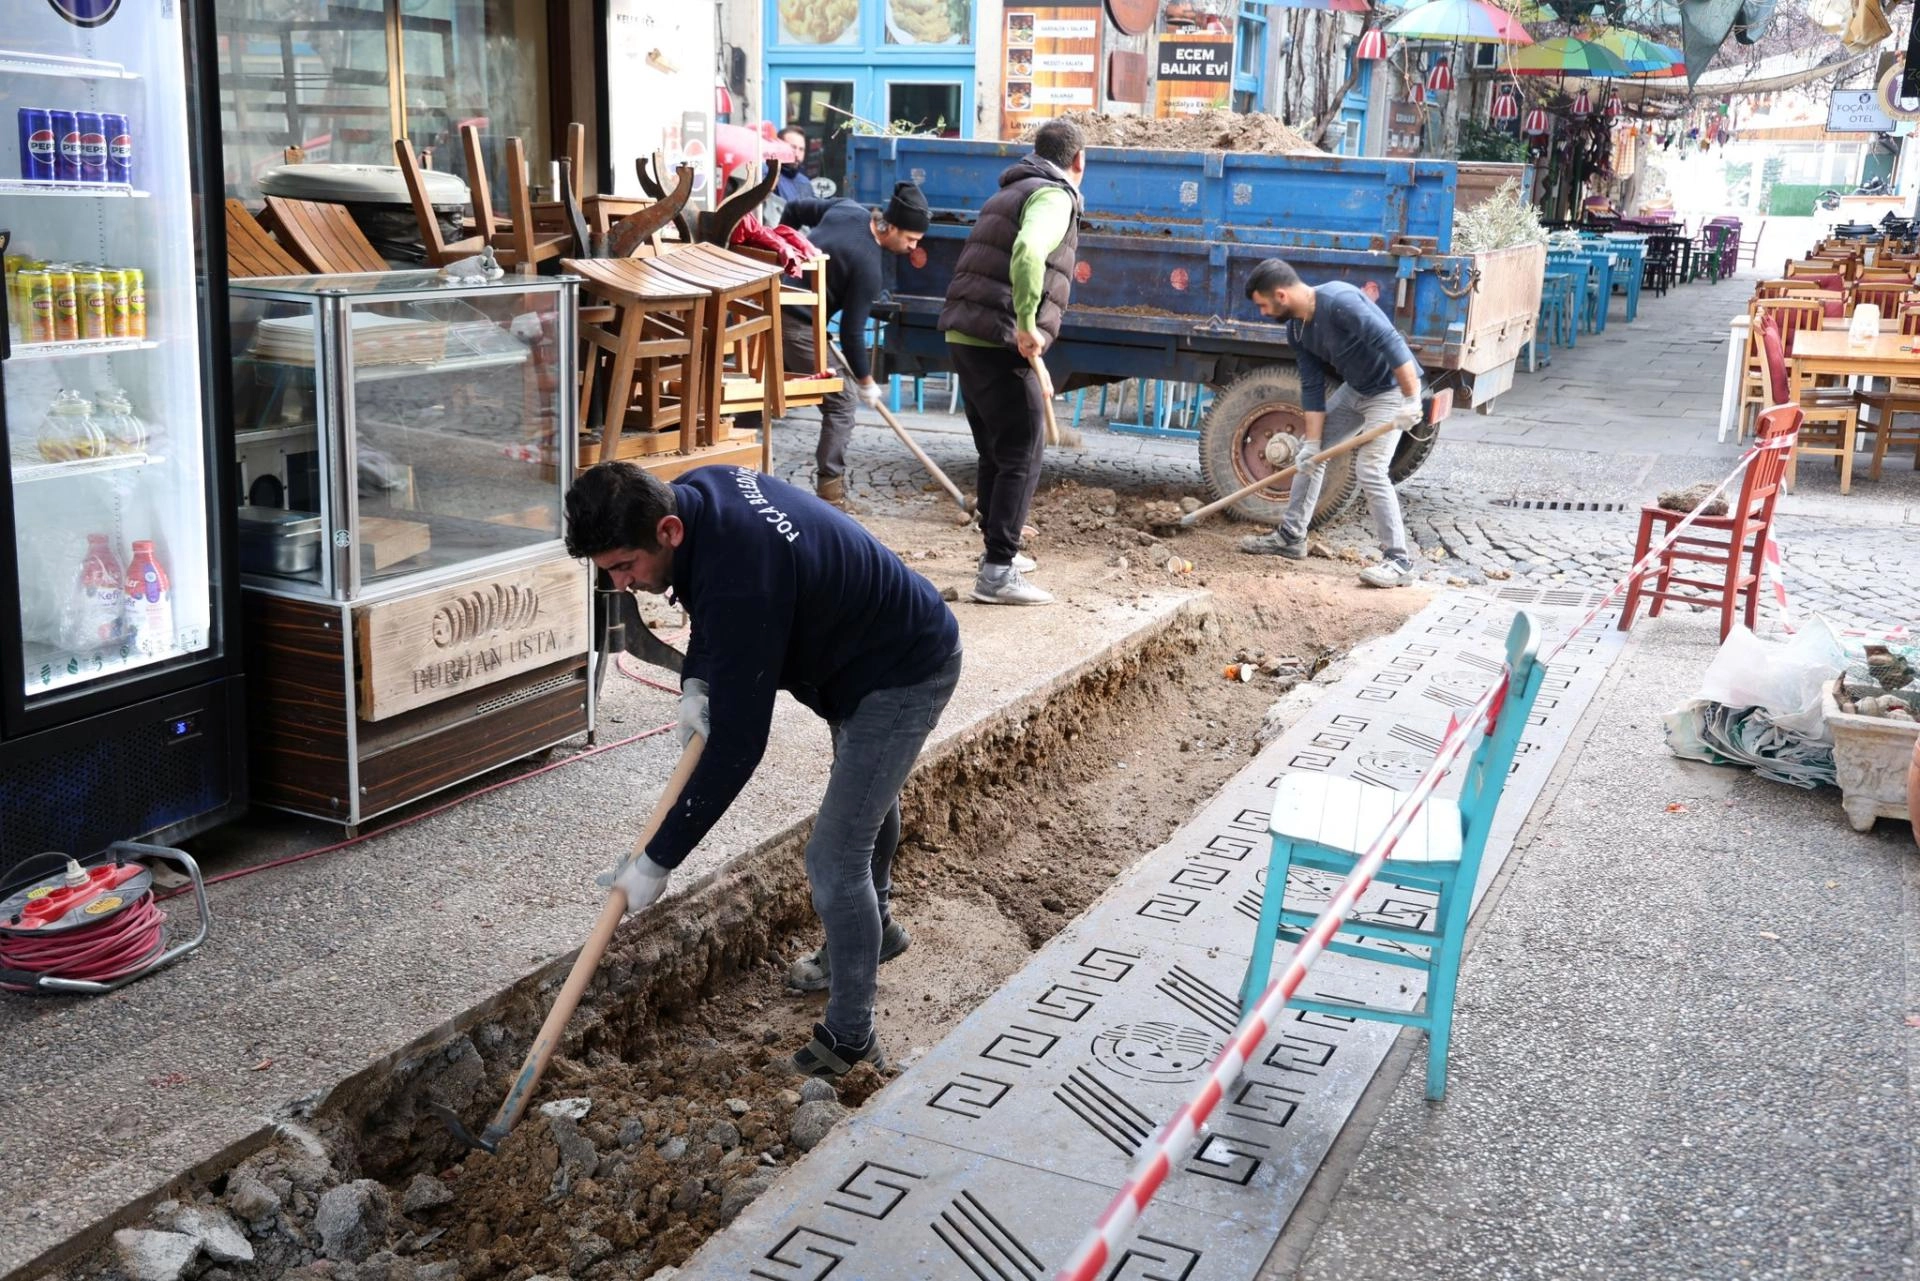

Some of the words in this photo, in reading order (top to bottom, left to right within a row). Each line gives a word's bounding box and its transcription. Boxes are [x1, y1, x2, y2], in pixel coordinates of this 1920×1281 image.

[1175, 48, 1215, 61] ECEM
[1160, 62, 1202, 75] BALIK
[1205, 61, 1229, 76] EVİ
[1836, 103, 1864, 113] FOÇA
[1849, 115, 1874, 123] OTEL
[757, 505, 800, 543] FOÇA
[412, 645, 502, 694] BURHAN
[510, 629, 557, 663] USTA
